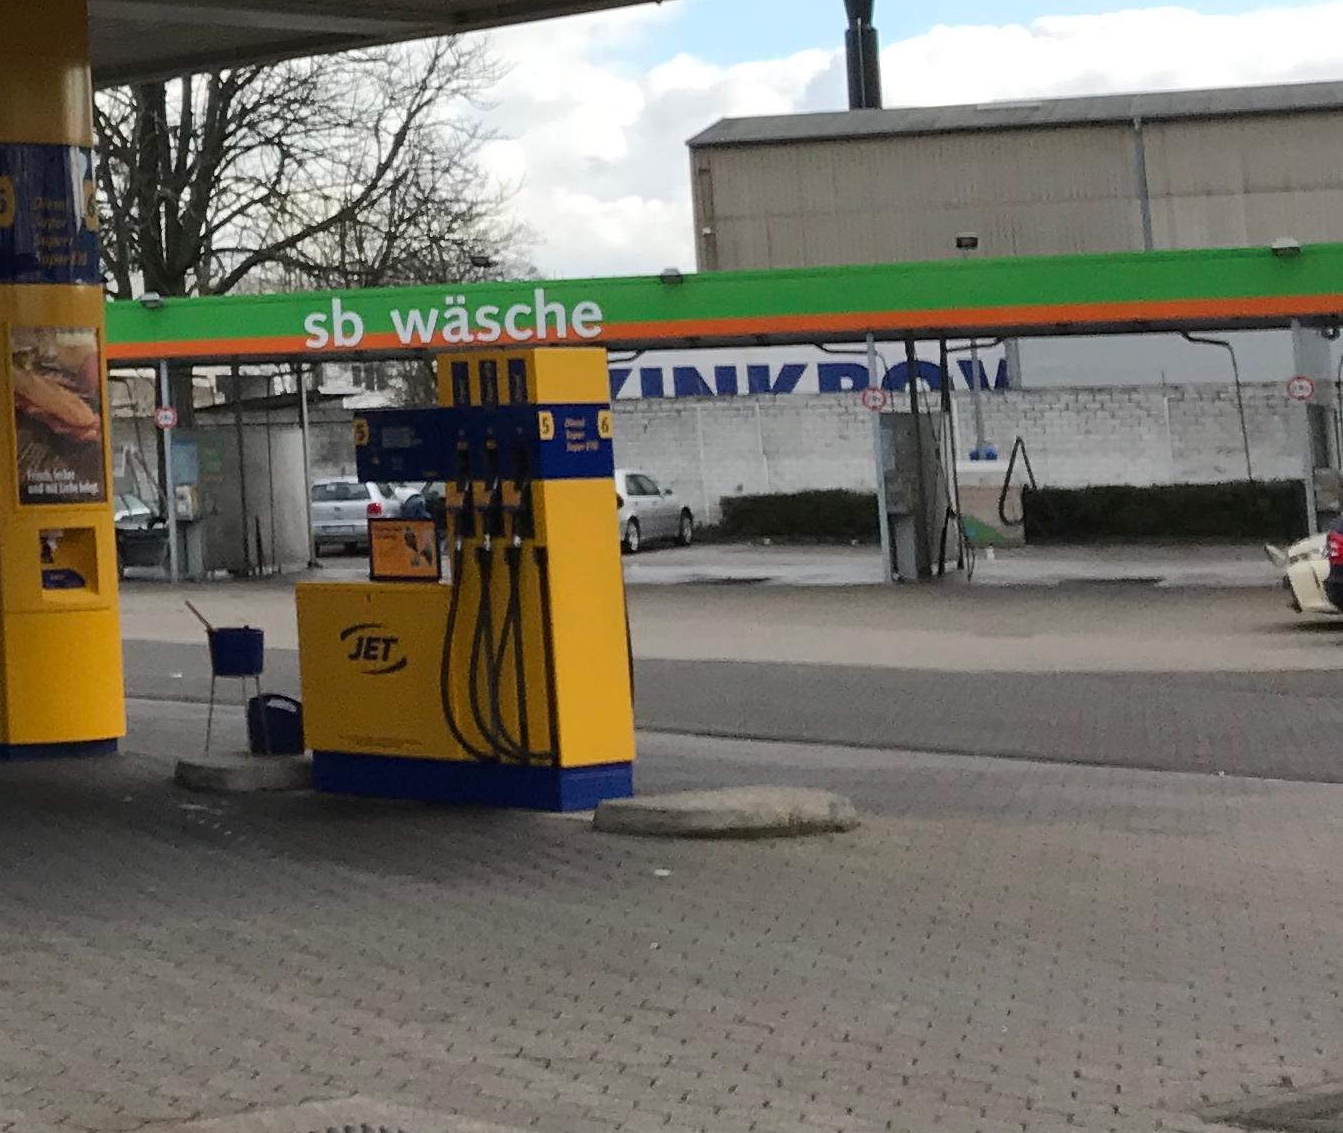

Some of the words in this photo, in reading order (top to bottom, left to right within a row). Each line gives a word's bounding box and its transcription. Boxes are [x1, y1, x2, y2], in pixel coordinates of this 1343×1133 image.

[303, 297, 364, 349] sb
[390, 288, 603, 345] wäsche
[347, 635, 399, 662] JET
